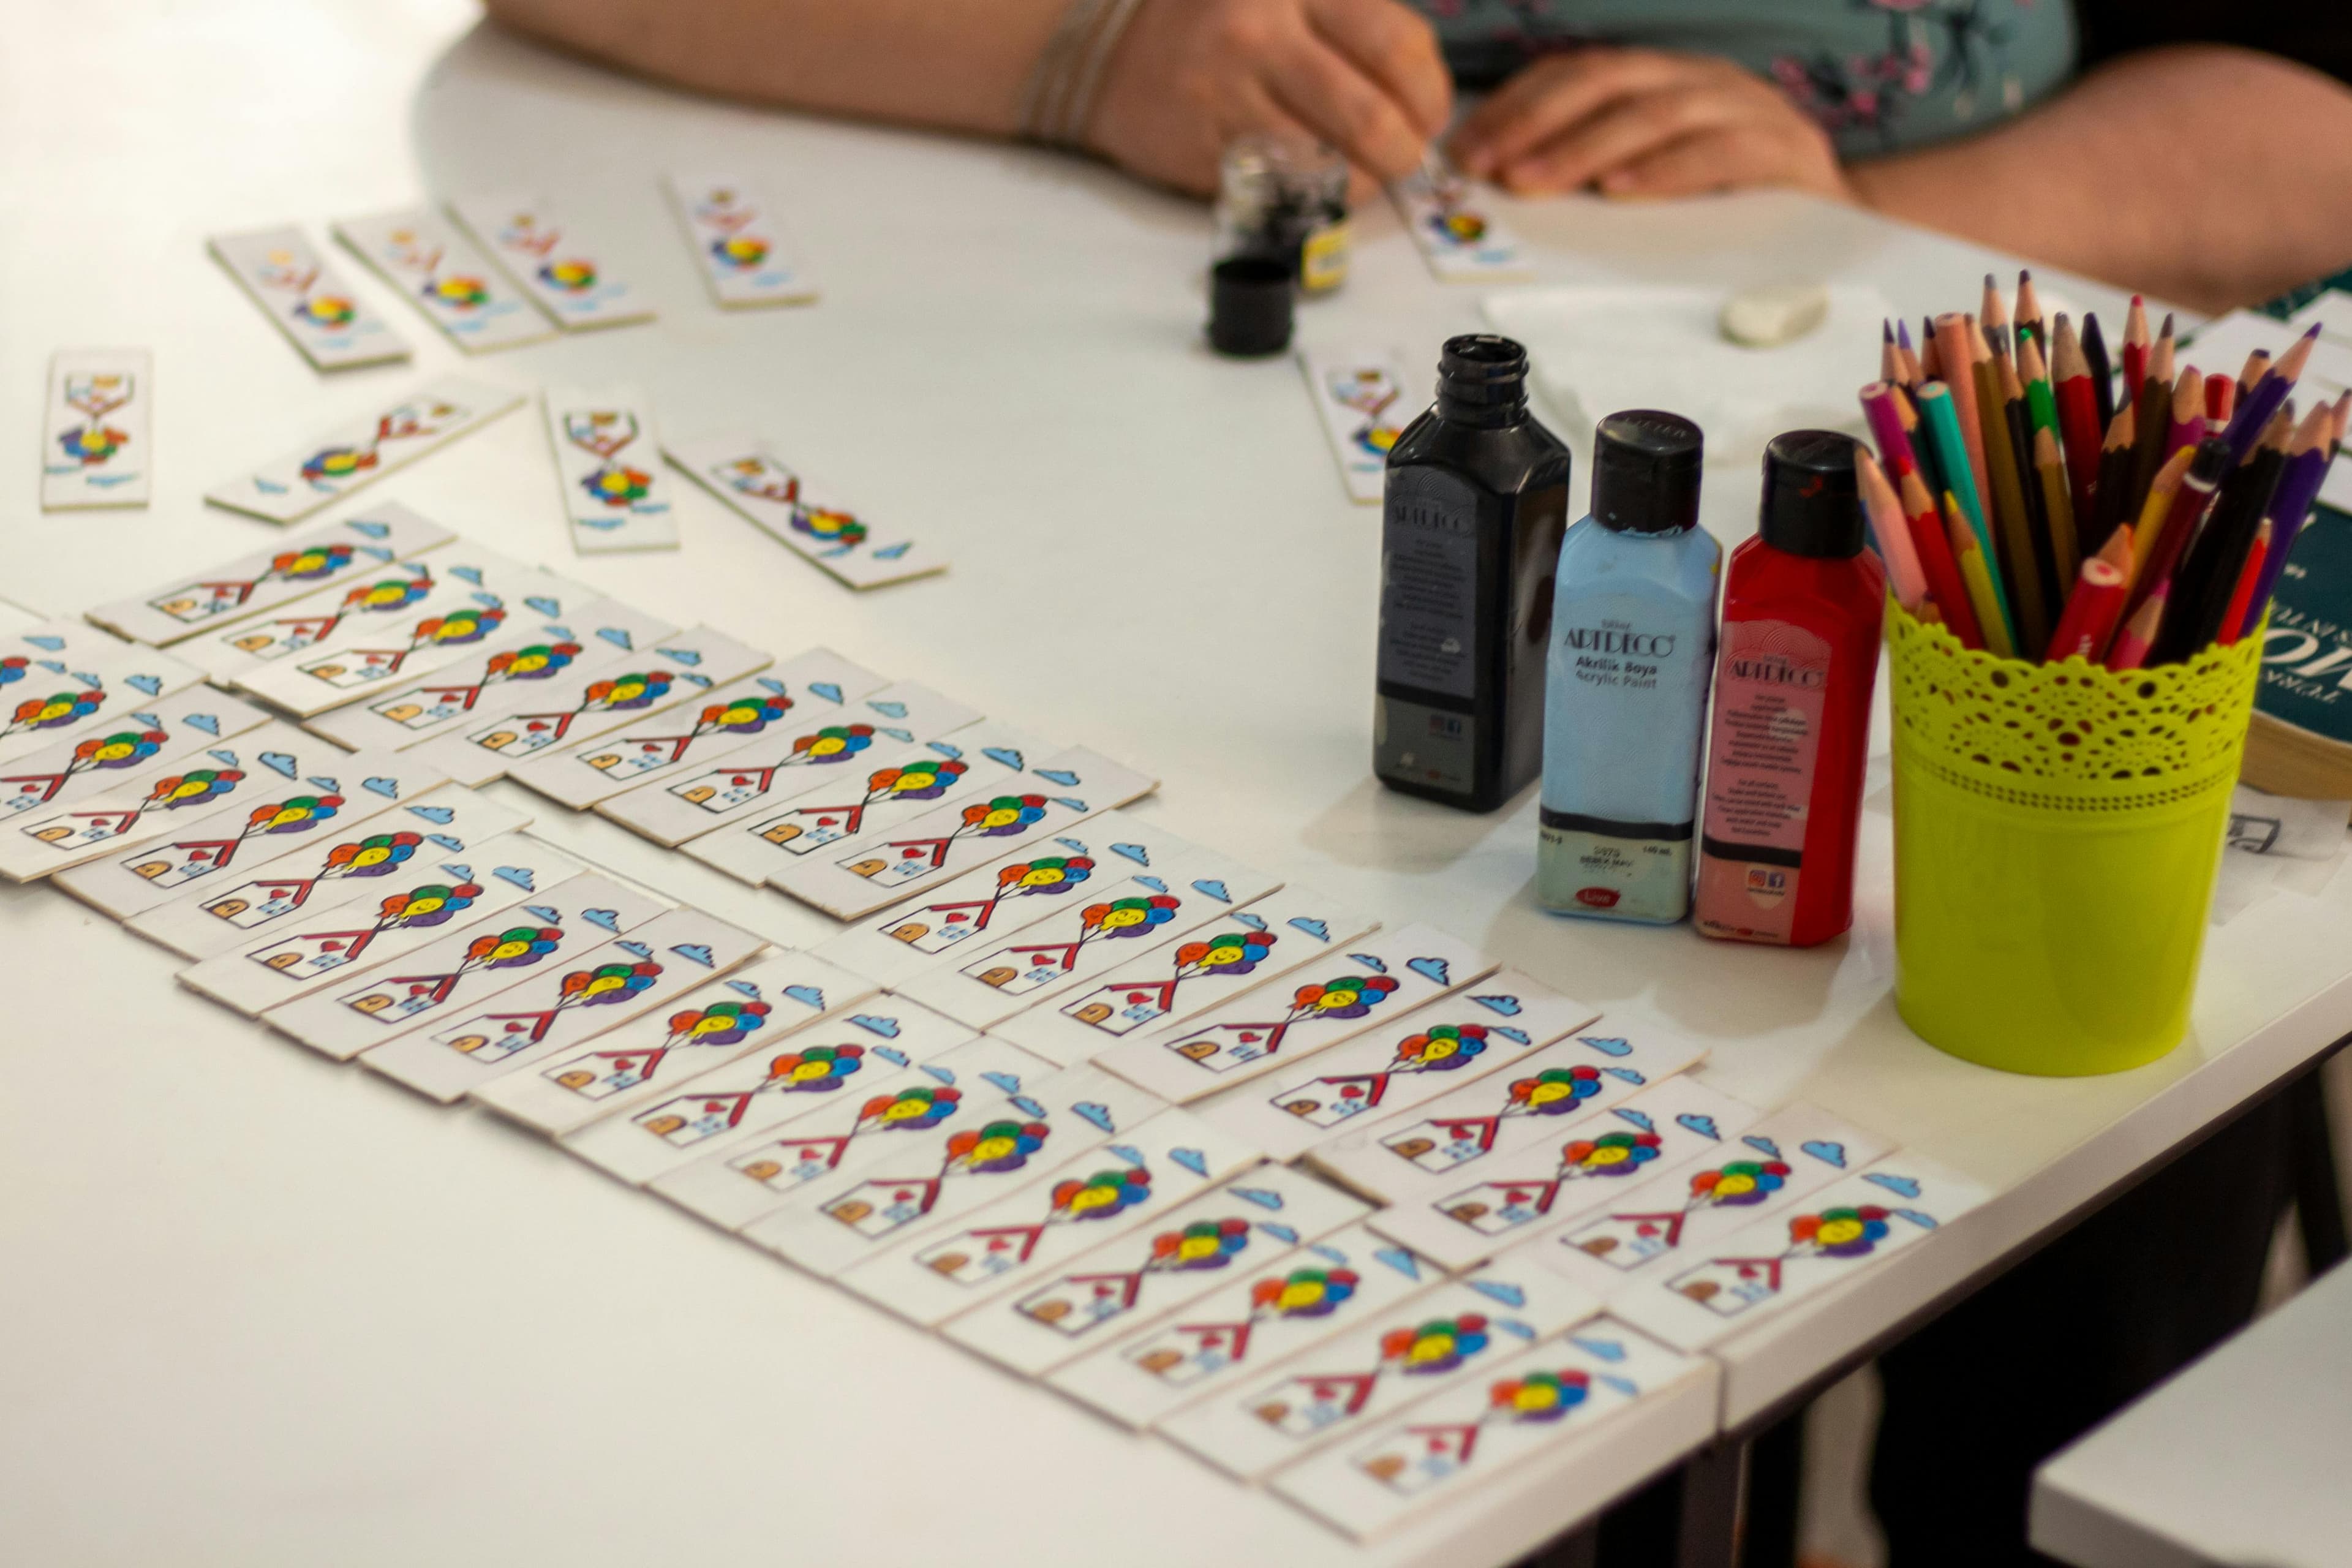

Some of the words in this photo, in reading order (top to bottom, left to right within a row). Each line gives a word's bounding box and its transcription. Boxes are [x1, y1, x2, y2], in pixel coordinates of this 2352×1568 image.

[1576, 655, 1619, 673] Akrilik
[1624, 661, 1657, 678] Boya
[1575, 669, 1618, 687] Acrylic
[1623, 675, 1657, 690] Paint
